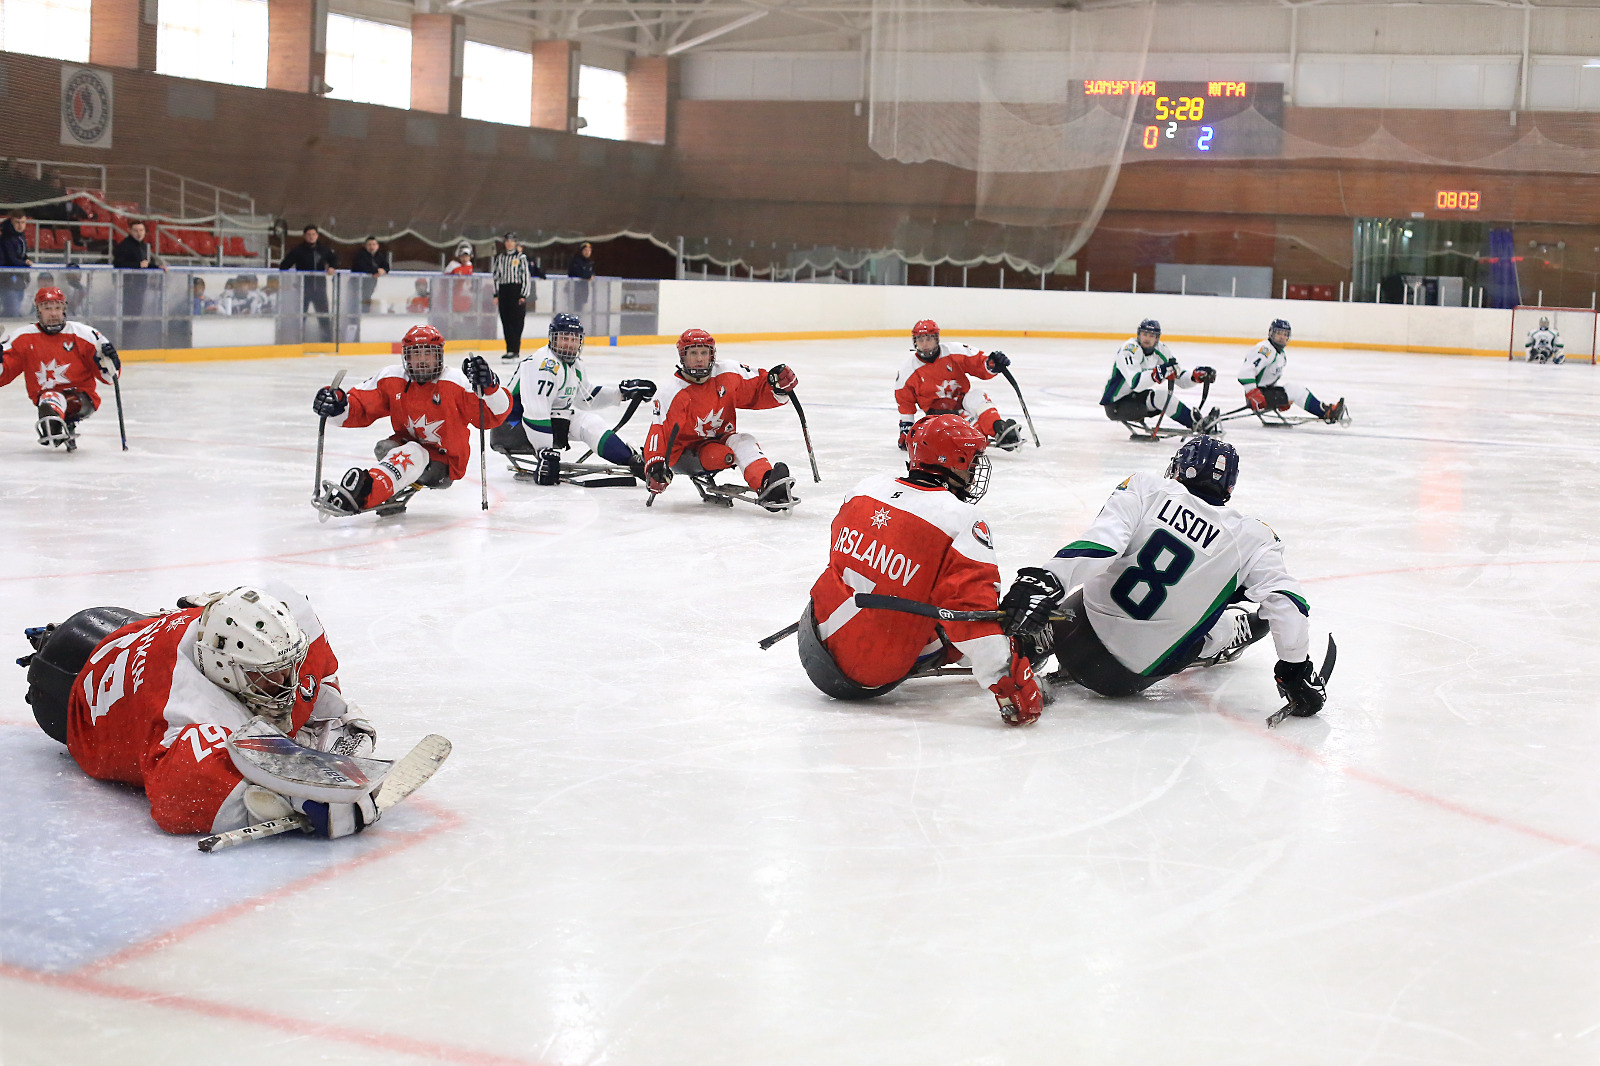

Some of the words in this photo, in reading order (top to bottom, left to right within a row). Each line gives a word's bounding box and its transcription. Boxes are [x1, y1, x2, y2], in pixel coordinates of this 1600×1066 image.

[1084, 80, 1157, 96] УДМУРТИЯ
[1207, 81, 1247, 97] ЮГРА
[1155, 96, 1205, 121] 5:28
[1143, 124, 1159, 149] 0
[1165, 121, 1178, 139] 2
[1197, 126, 1214, 151] 2
[537, 380, 554, 396] 77
[649, 434, 659, 452] 11
[1157, 499, 1220, 549] LISOV
[1110, 528, 1195, 620] 8
[181, 723, 228, 763] 29
